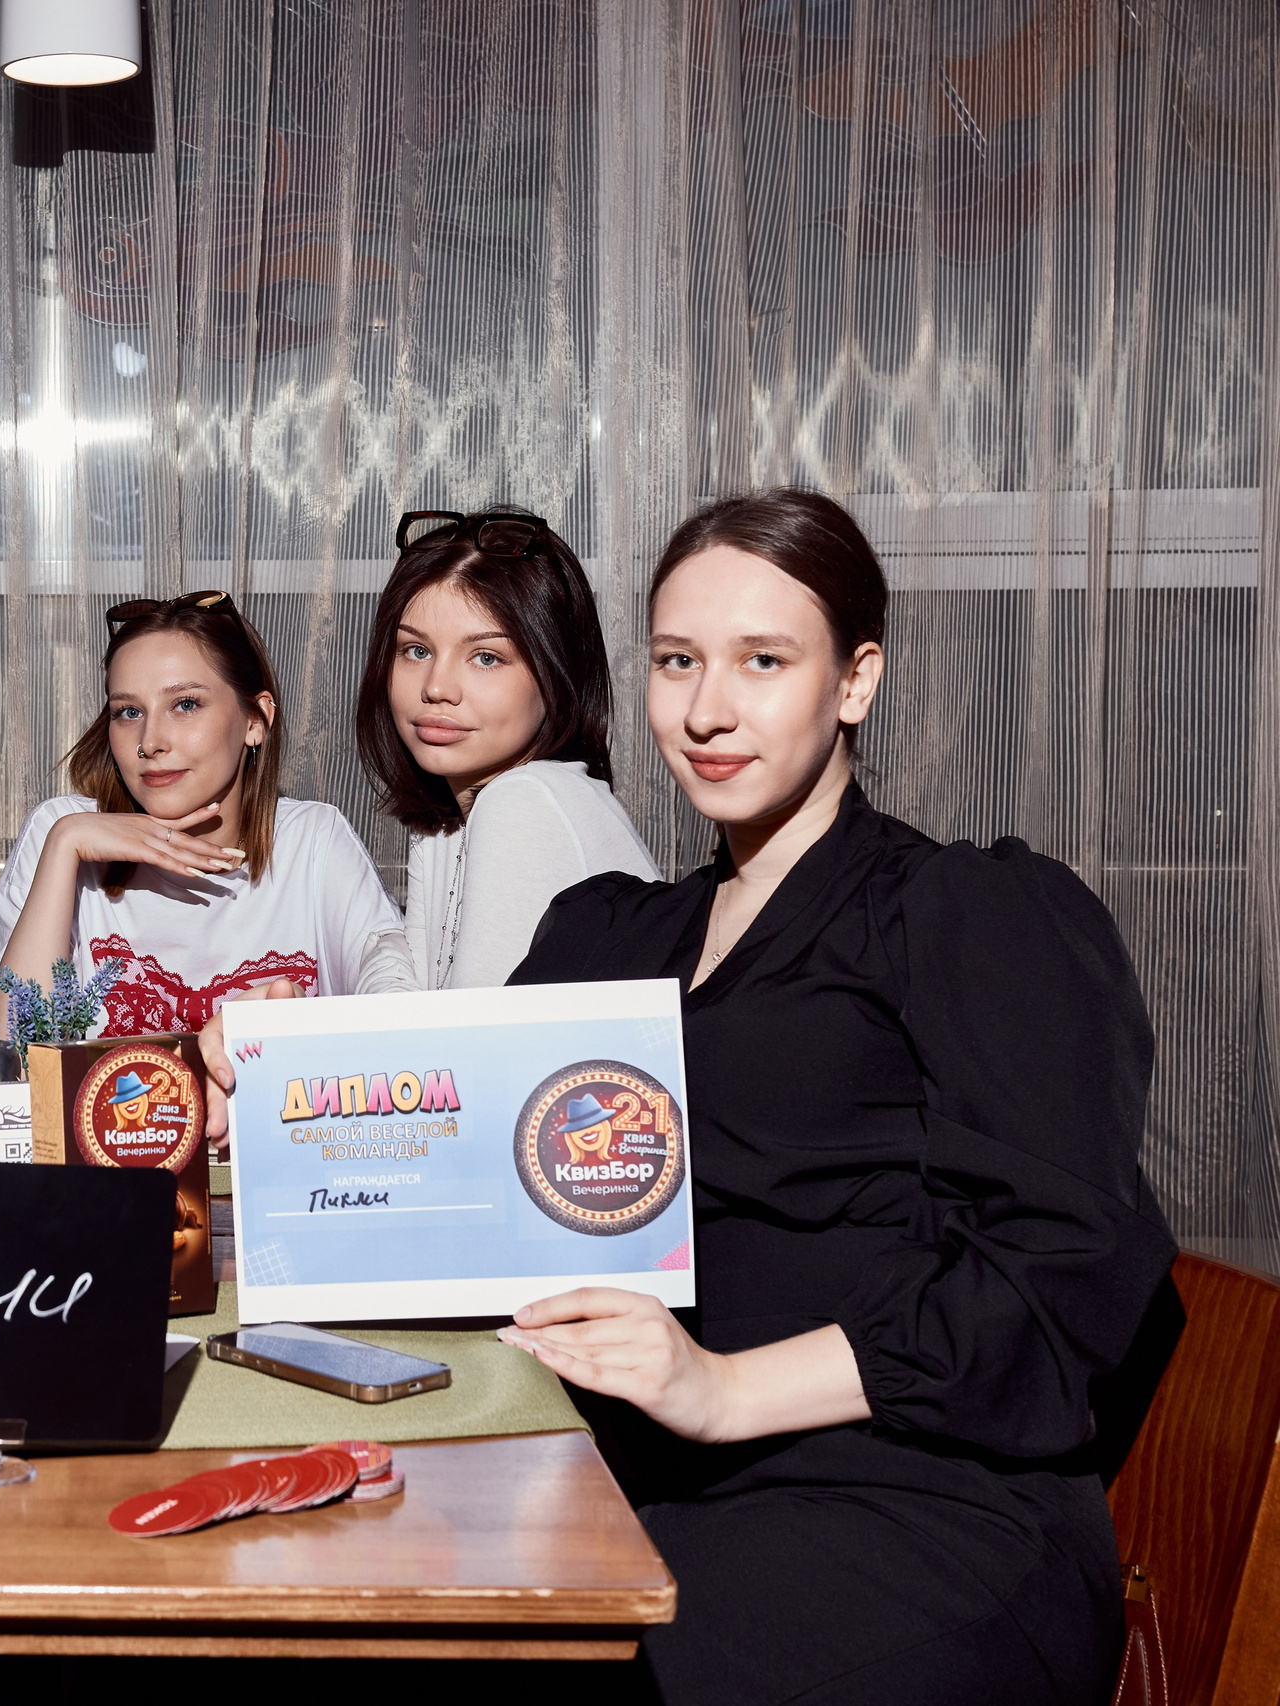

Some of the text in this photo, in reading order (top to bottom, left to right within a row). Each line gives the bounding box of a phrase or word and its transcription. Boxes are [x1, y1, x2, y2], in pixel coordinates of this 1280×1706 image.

[280, 1069, 461, 1124] ДИПЛОМ
[104, 1127, 178, 1145] КвизБор
[291, 1117, 458, 1144] САМОЙ ВЕСЕЛОЙ
[116, 1147, 166, 1157] Вечеринка
[322, 1141, 428, 1161] КОМАНДЫ
[333, 1174, 421, 1188] НАГРАЖДАЕТСЯ
[555, 1161, 654, 1182] КвизБор
[572, 1185, 639, 1196] Вечеринка
